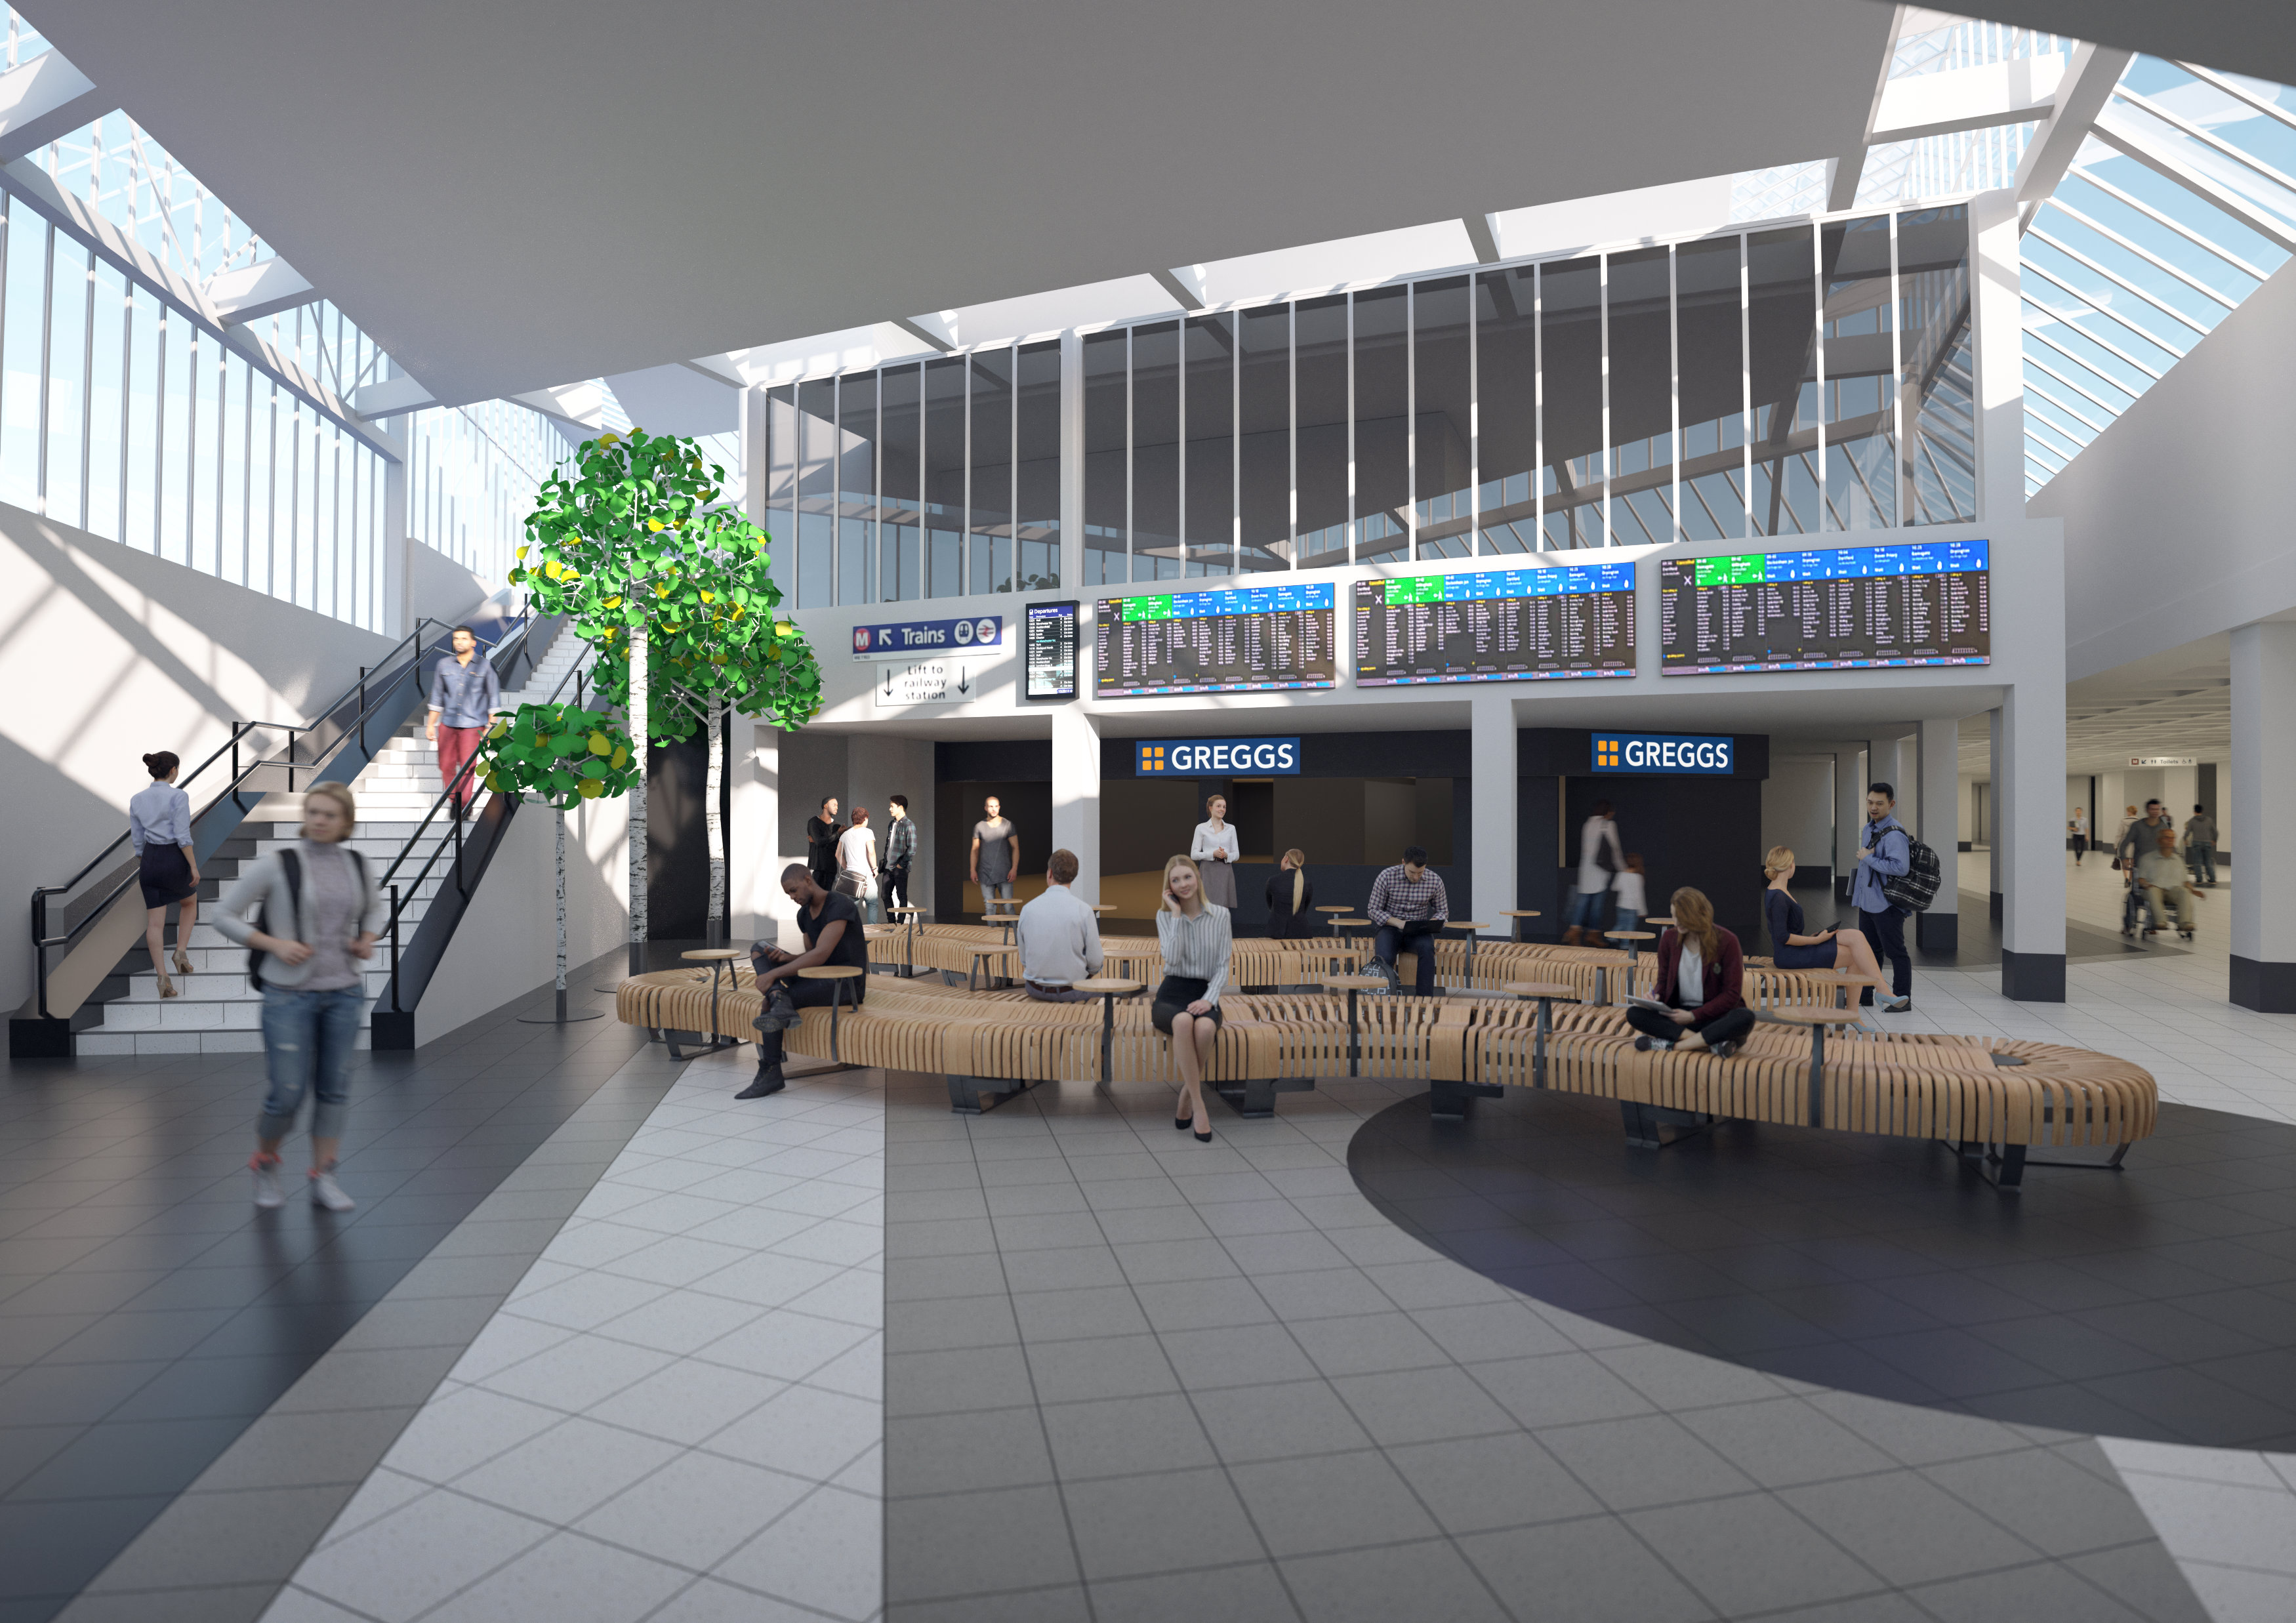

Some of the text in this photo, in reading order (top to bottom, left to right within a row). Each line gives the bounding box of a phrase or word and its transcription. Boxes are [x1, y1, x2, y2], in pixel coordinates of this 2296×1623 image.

[901, 626, 945, 646] Trains
[908, 666, 927, 674] Lift
[905, 678, 947, 689] railway
[1172, 743, 1293, 770] GREGGS
[1626, 741, 1728, 768] GREGGS
